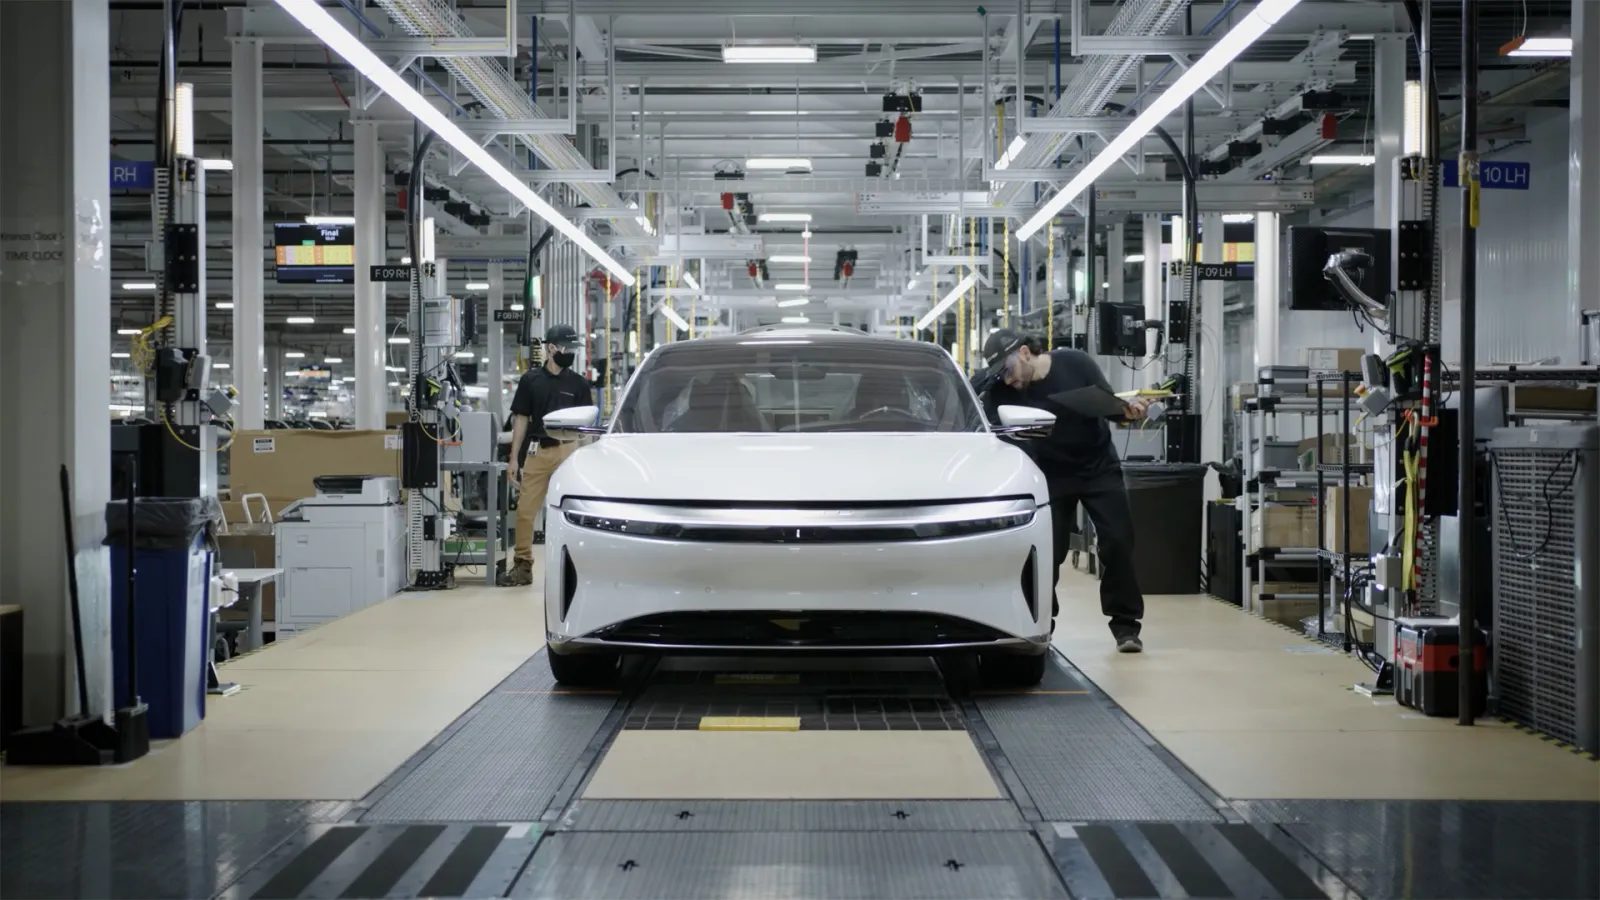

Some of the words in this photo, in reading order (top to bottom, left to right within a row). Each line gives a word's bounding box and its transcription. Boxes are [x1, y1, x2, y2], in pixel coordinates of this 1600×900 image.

[113, 166, 137, 182] RH
[1484, 165, 1502, 183] 10
[1505, 167, 1526, 184] LH
[375, 269, 381, 278] F
[382, 269, 395, 278] 09
[395, 269, 410, 279] RH
[1197, 267, 1204, 277] F
[1205, 267, 1217, 277] 09
[1219, 267, 1233, 277] LH
